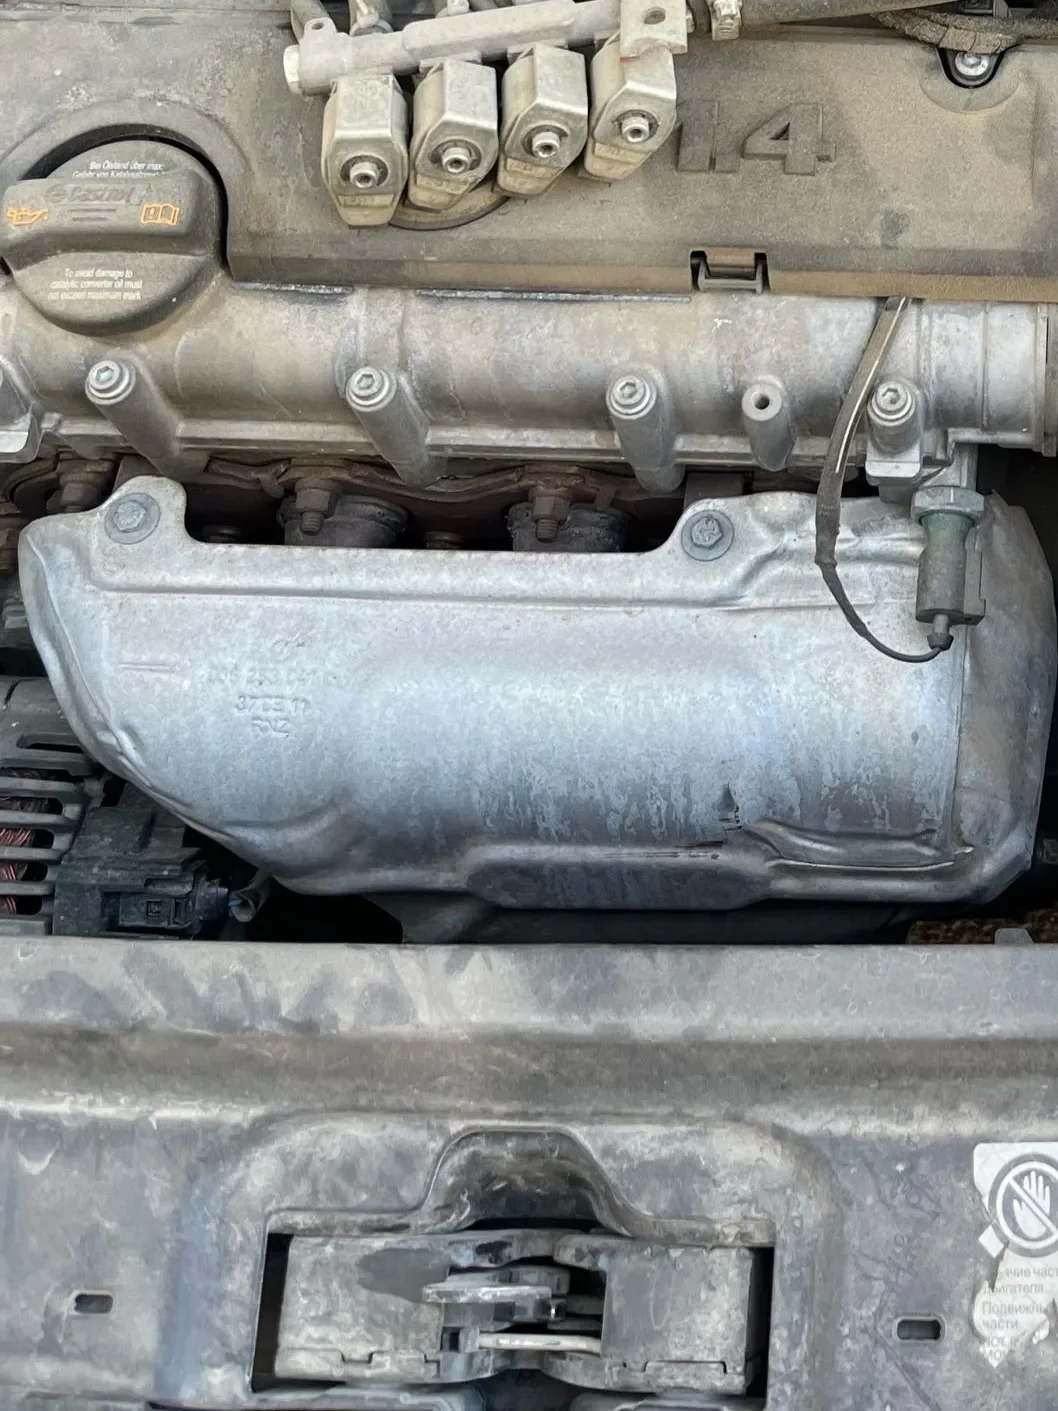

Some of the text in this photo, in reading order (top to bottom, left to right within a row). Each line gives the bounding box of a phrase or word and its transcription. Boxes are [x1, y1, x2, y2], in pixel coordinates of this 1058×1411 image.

[75, 268, 95, 278] avoid
[95, 268, 124, 280] damage
[125, 269, 133, 278] to
[50, 279, 143, 290] catalytic converter oil must
[122, 291, 141, 300] mark
[982, 1319, 1019, 1330] части
